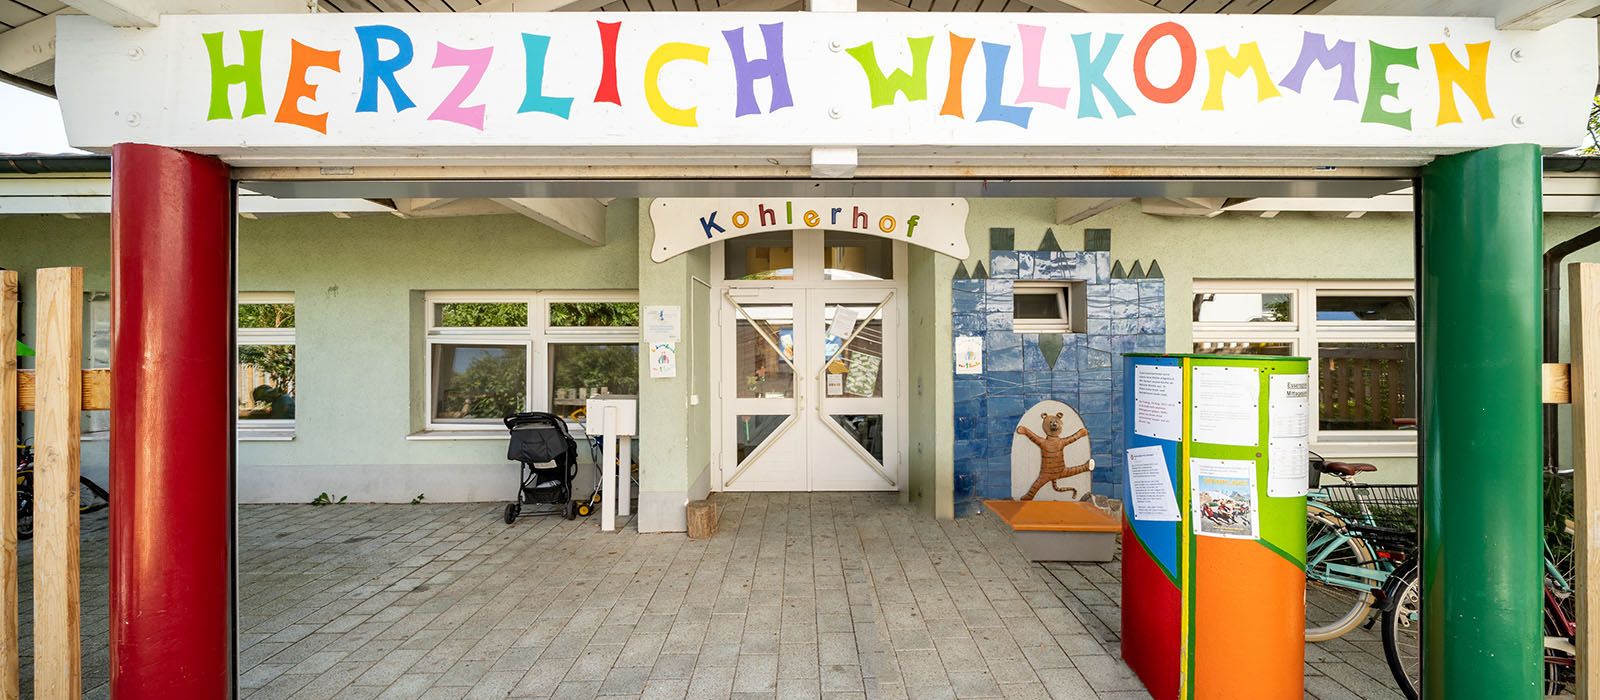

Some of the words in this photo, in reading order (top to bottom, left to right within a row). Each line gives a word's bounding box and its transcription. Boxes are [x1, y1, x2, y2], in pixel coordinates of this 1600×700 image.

[202, 20, 793, 134] HERZLICH
[845, 22, 1495, 131] WILLKOMMEN
[700, 201, 920, 239] Kohlerhof
